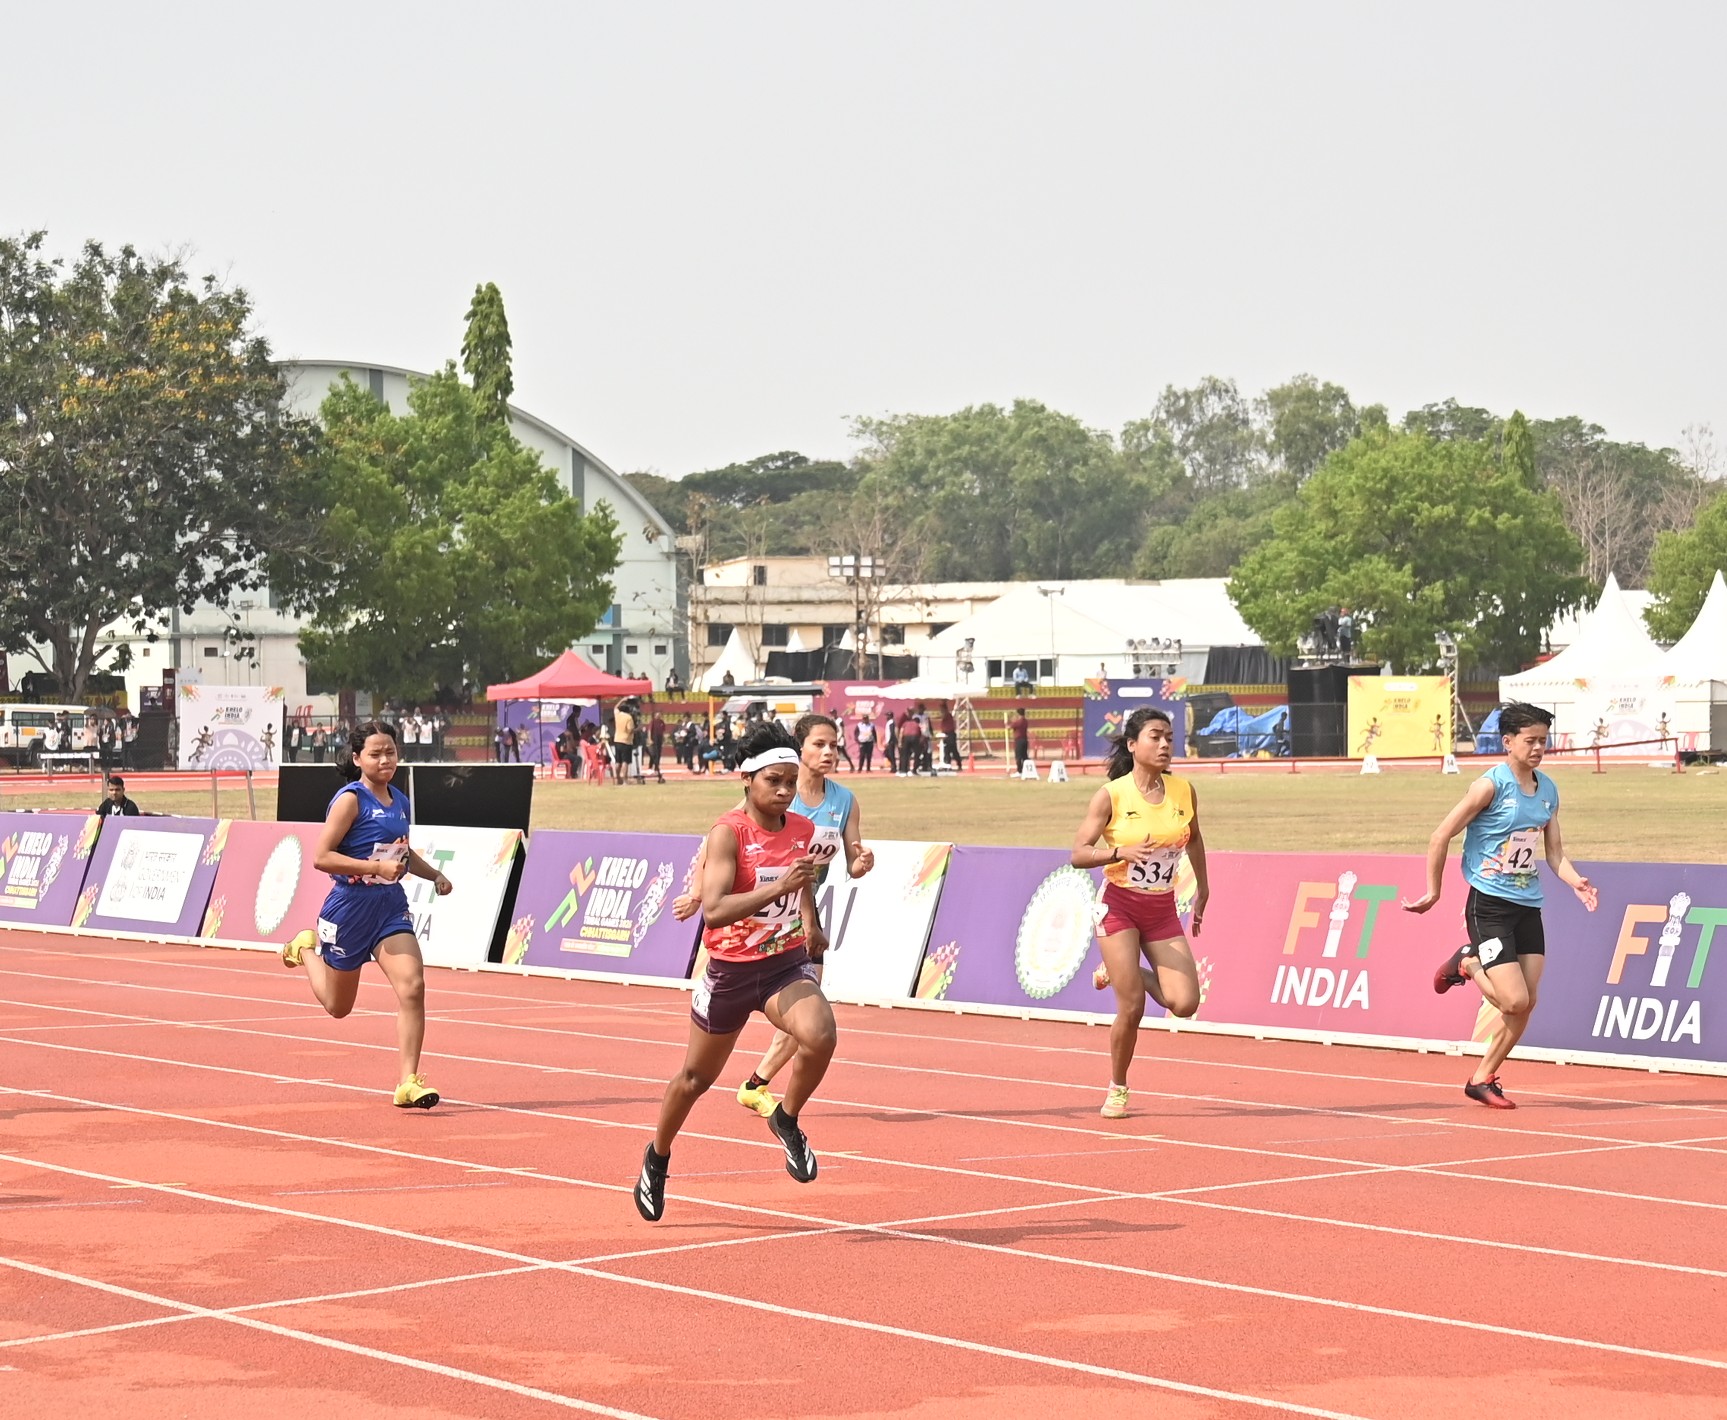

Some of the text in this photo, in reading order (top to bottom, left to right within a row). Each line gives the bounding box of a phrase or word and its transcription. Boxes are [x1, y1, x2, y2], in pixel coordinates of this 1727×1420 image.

[17, 831, 53, 857] KHELO
[8, 855, 42, 880] INDIA
[595, 856, 649, 889] KHELO
[1131, 860, 1174, 884] 534
[584, 887, 632, 920] INDIA
[1270, 965, 1369, 1010] INDIA
[1592, 995, 1701, 1044] INDIA
